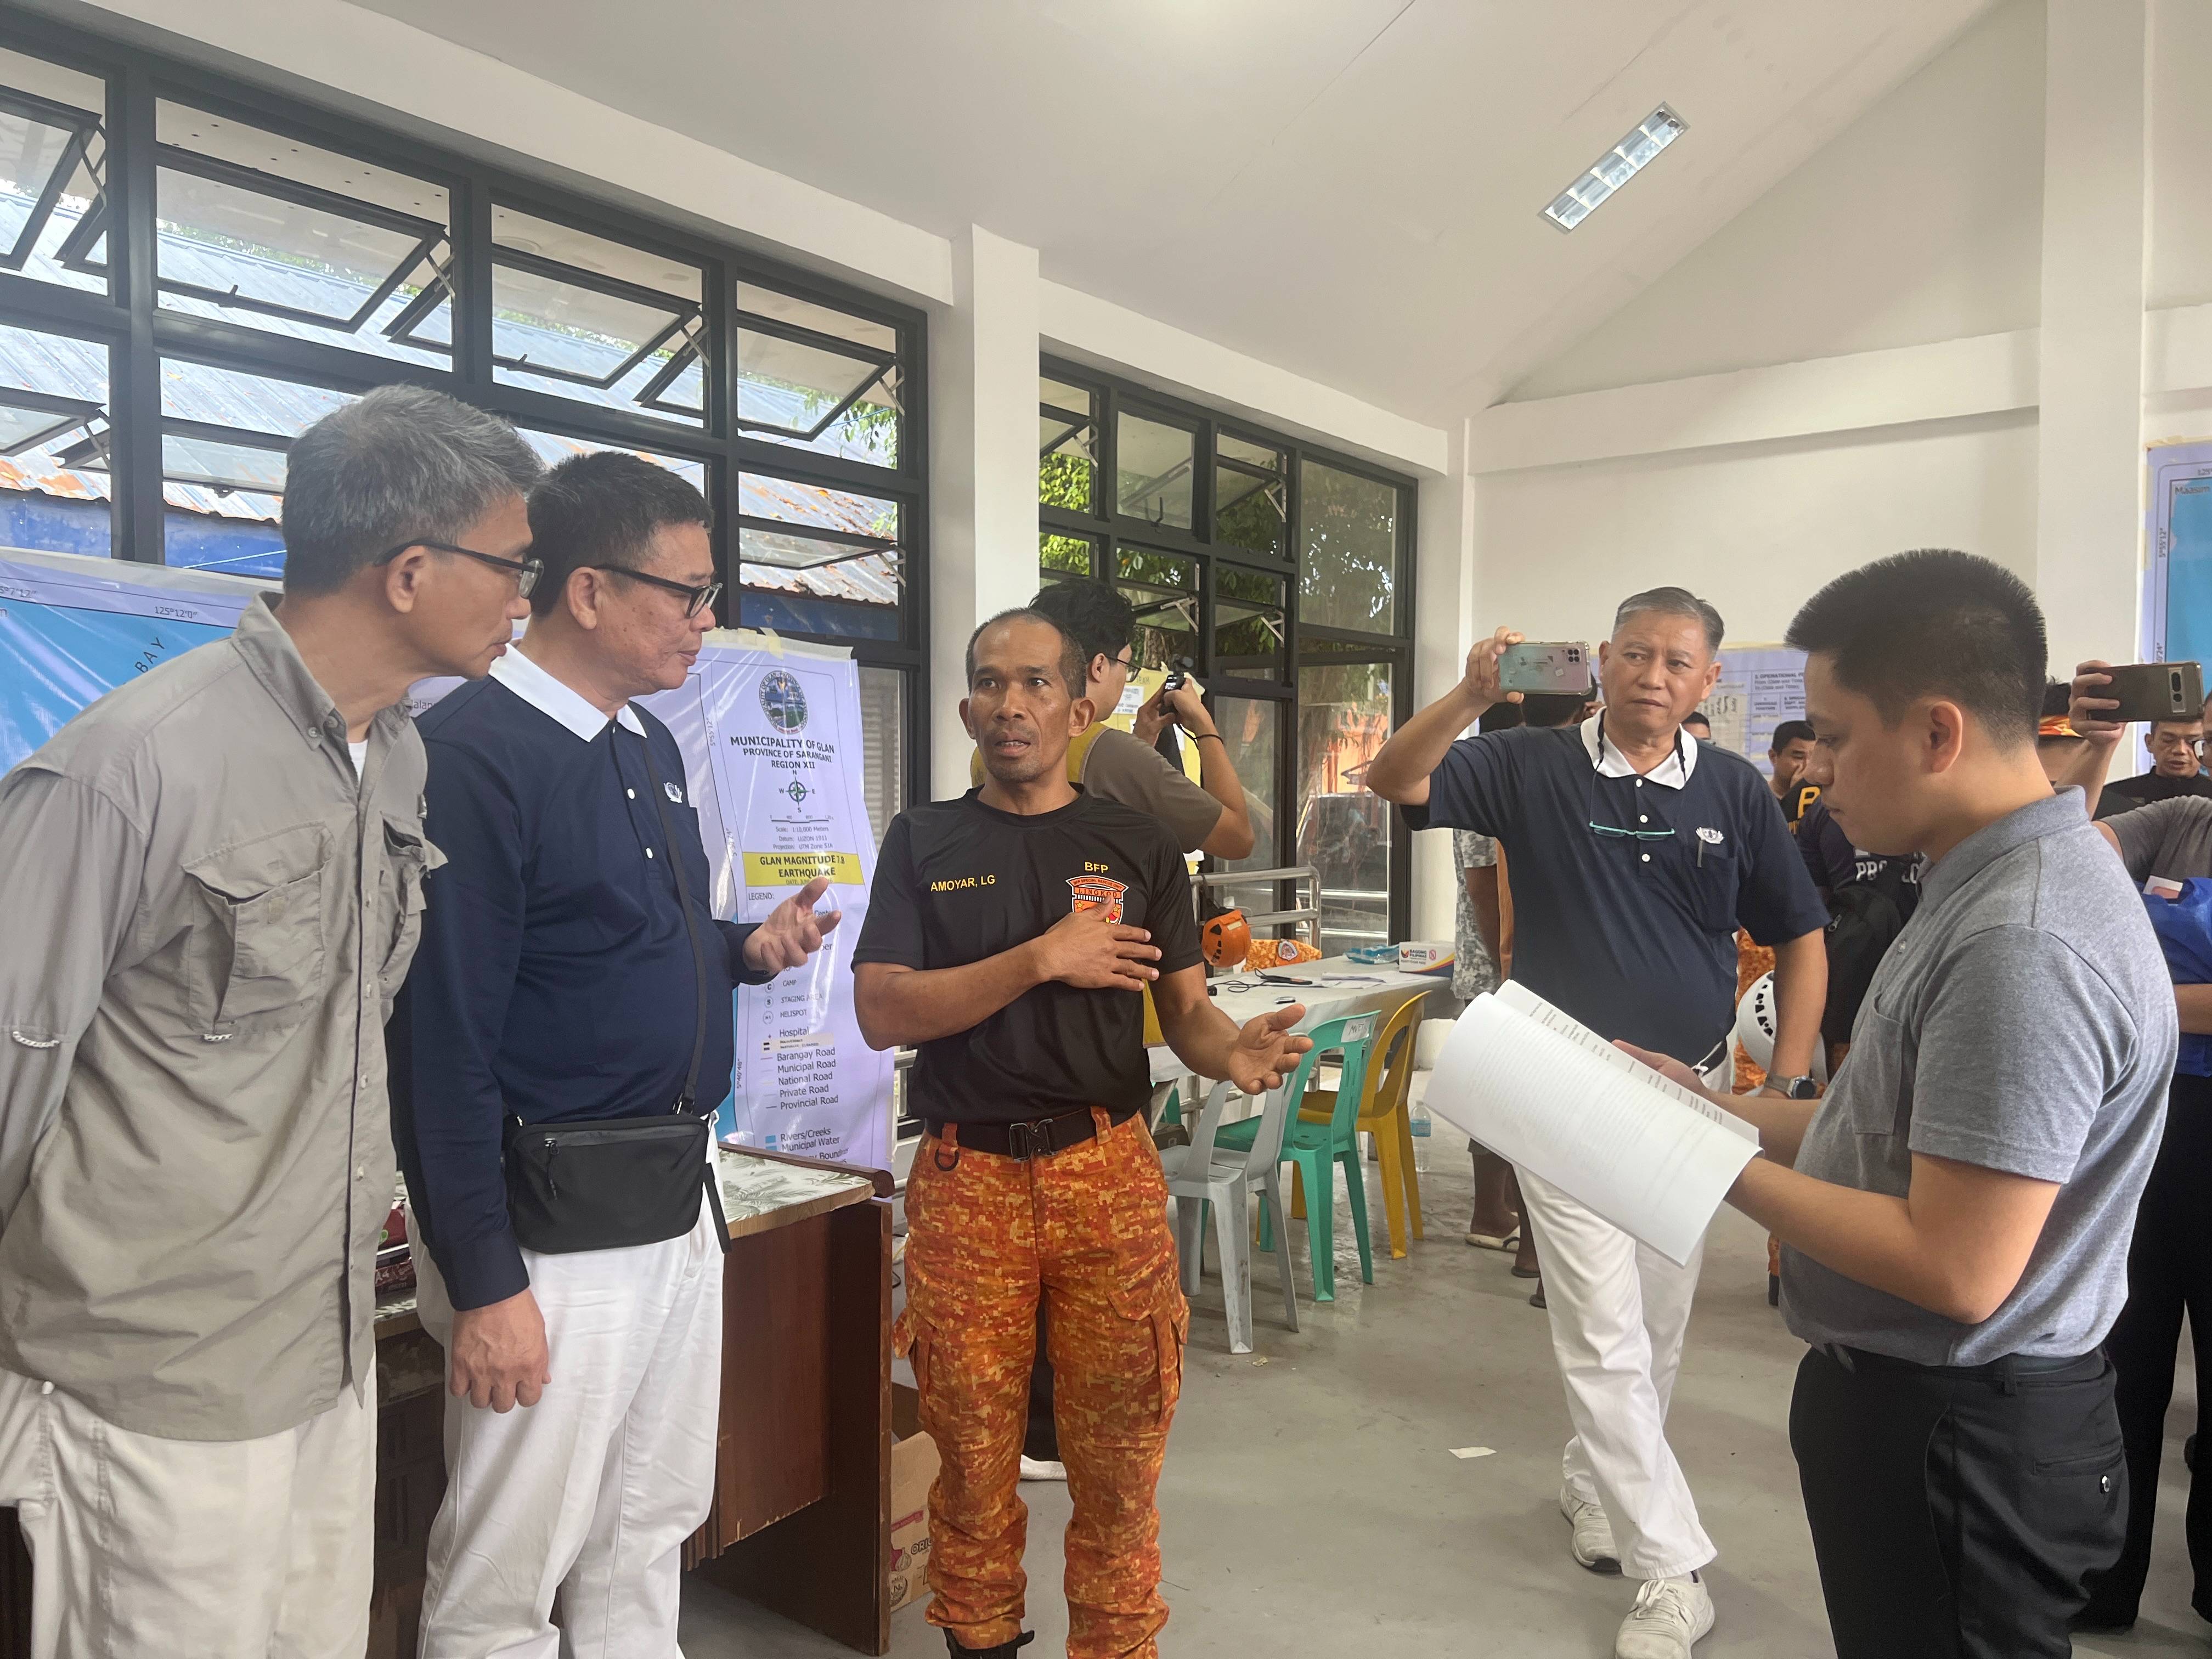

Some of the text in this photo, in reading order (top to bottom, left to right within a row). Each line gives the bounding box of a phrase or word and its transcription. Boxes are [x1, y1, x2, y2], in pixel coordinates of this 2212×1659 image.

[134, 637, 166, 674] BAY
[730, 736, 835, 754] MUNICIPALITY OF GLAN
[743, 748, 781, 758] PROVINCE
[796, 750, 832, 763] SARANGANI
[771, 760, 801, 769] REGION
[760, 856, 782, 865] GLAN
[783, 855, 836, 865] MAGNITUDE
[1085, 861, 1108, 873] BFP
[778, 867, 836, 879] EARTHQUAKE
[930, 874, 995, 891] AMOYAR, LG
[748, 892, 774, 901] LEGEND:
[781, 995, 805, 1003] STAGING
[780, 1009, 808, 1018] HELISPOT
[780, 1026, 809, 1037] Hospital
[777, 1047, 836, 1061] Barangay Road
[777, 1059, 836, 1074] Municipal Road
[778, 1071, 833, 1086] National Road
[780, 1084, 829, 1098] Private Road
[780, 1094, 838, 1110] Provincial Road
[780, 1127, 831, 1142] Rivers/Creeks
[782, 1137, 840, 1152] Municipal Water
